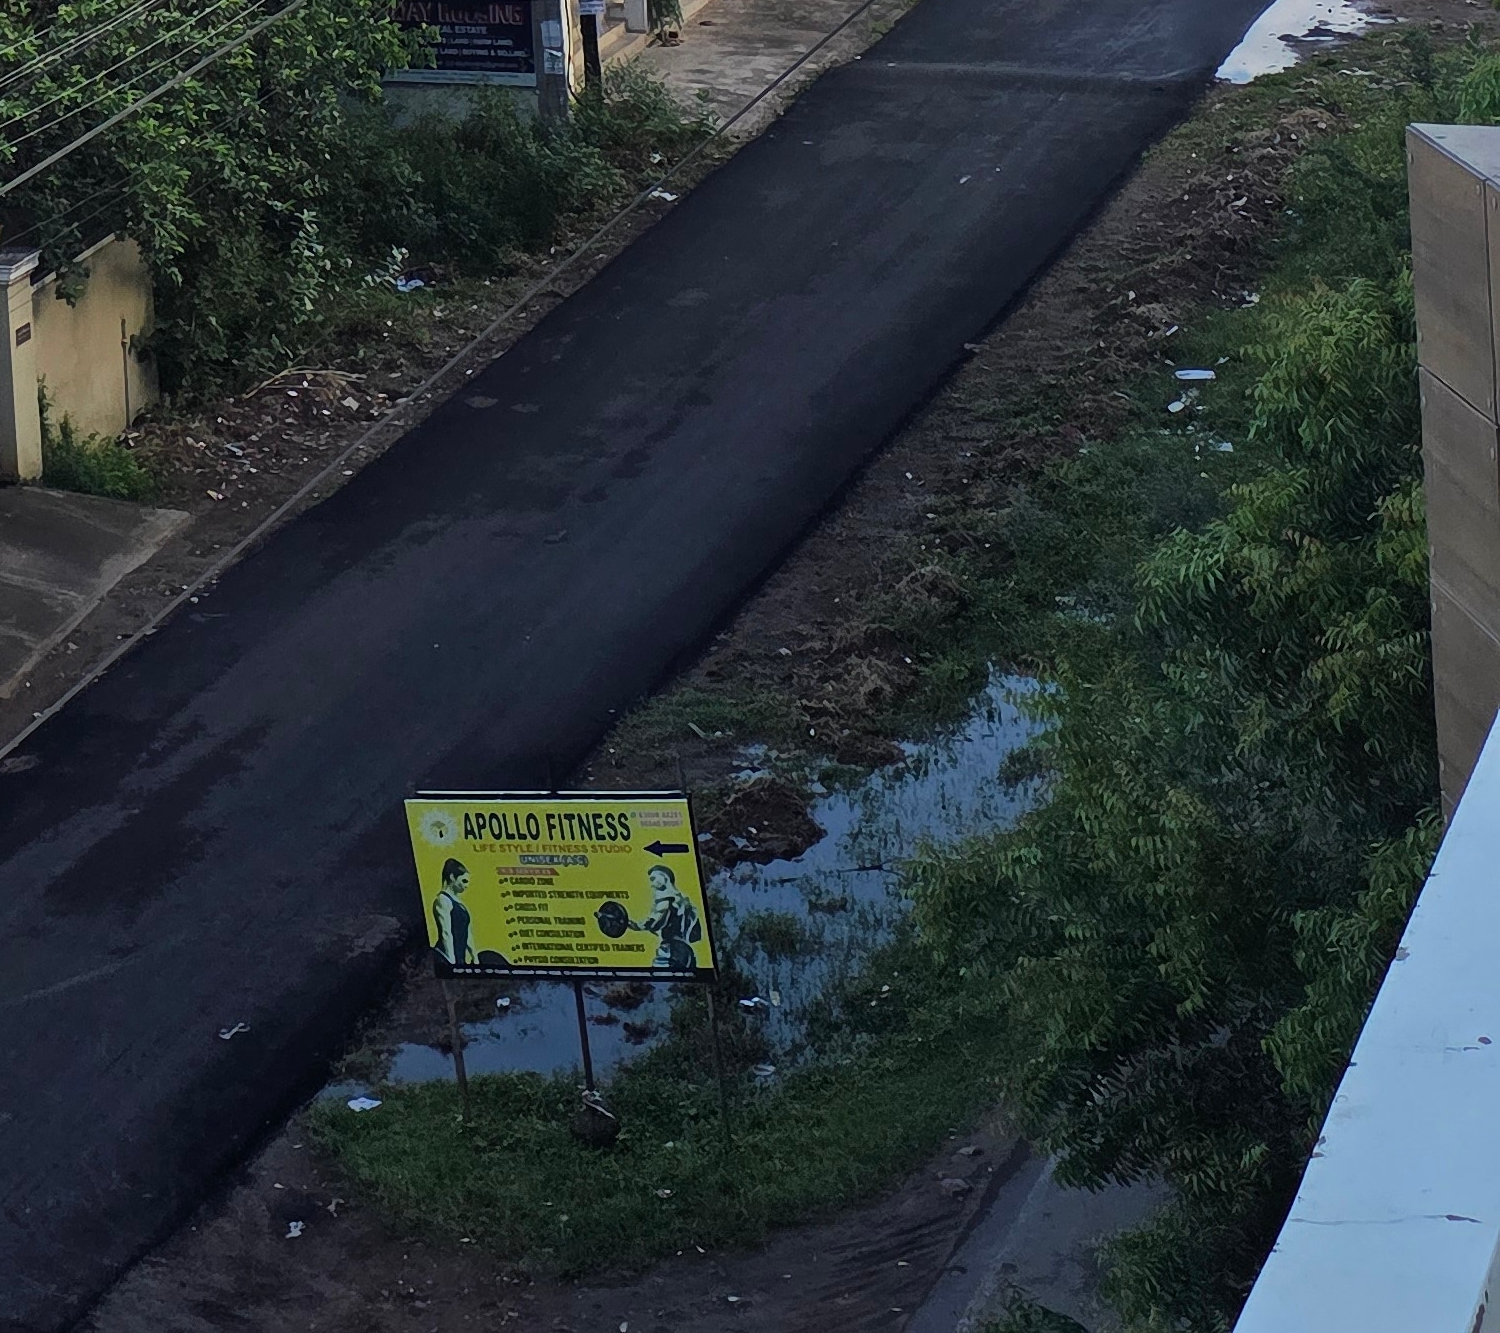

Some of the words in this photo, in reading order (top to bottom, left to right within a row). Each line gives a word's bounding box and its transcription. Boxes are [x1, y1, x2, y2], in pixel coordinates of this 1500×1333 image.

[463, 812, 541, 841] APOLLO
[546, 812, 632, 841] FITNESS
[472, 843, 497, 854] LIFE
[499, 843, 534, 854] STYLE
[541, 844, 588, 854] FITNESS
[591, 844, 633, 854] STUDIO
